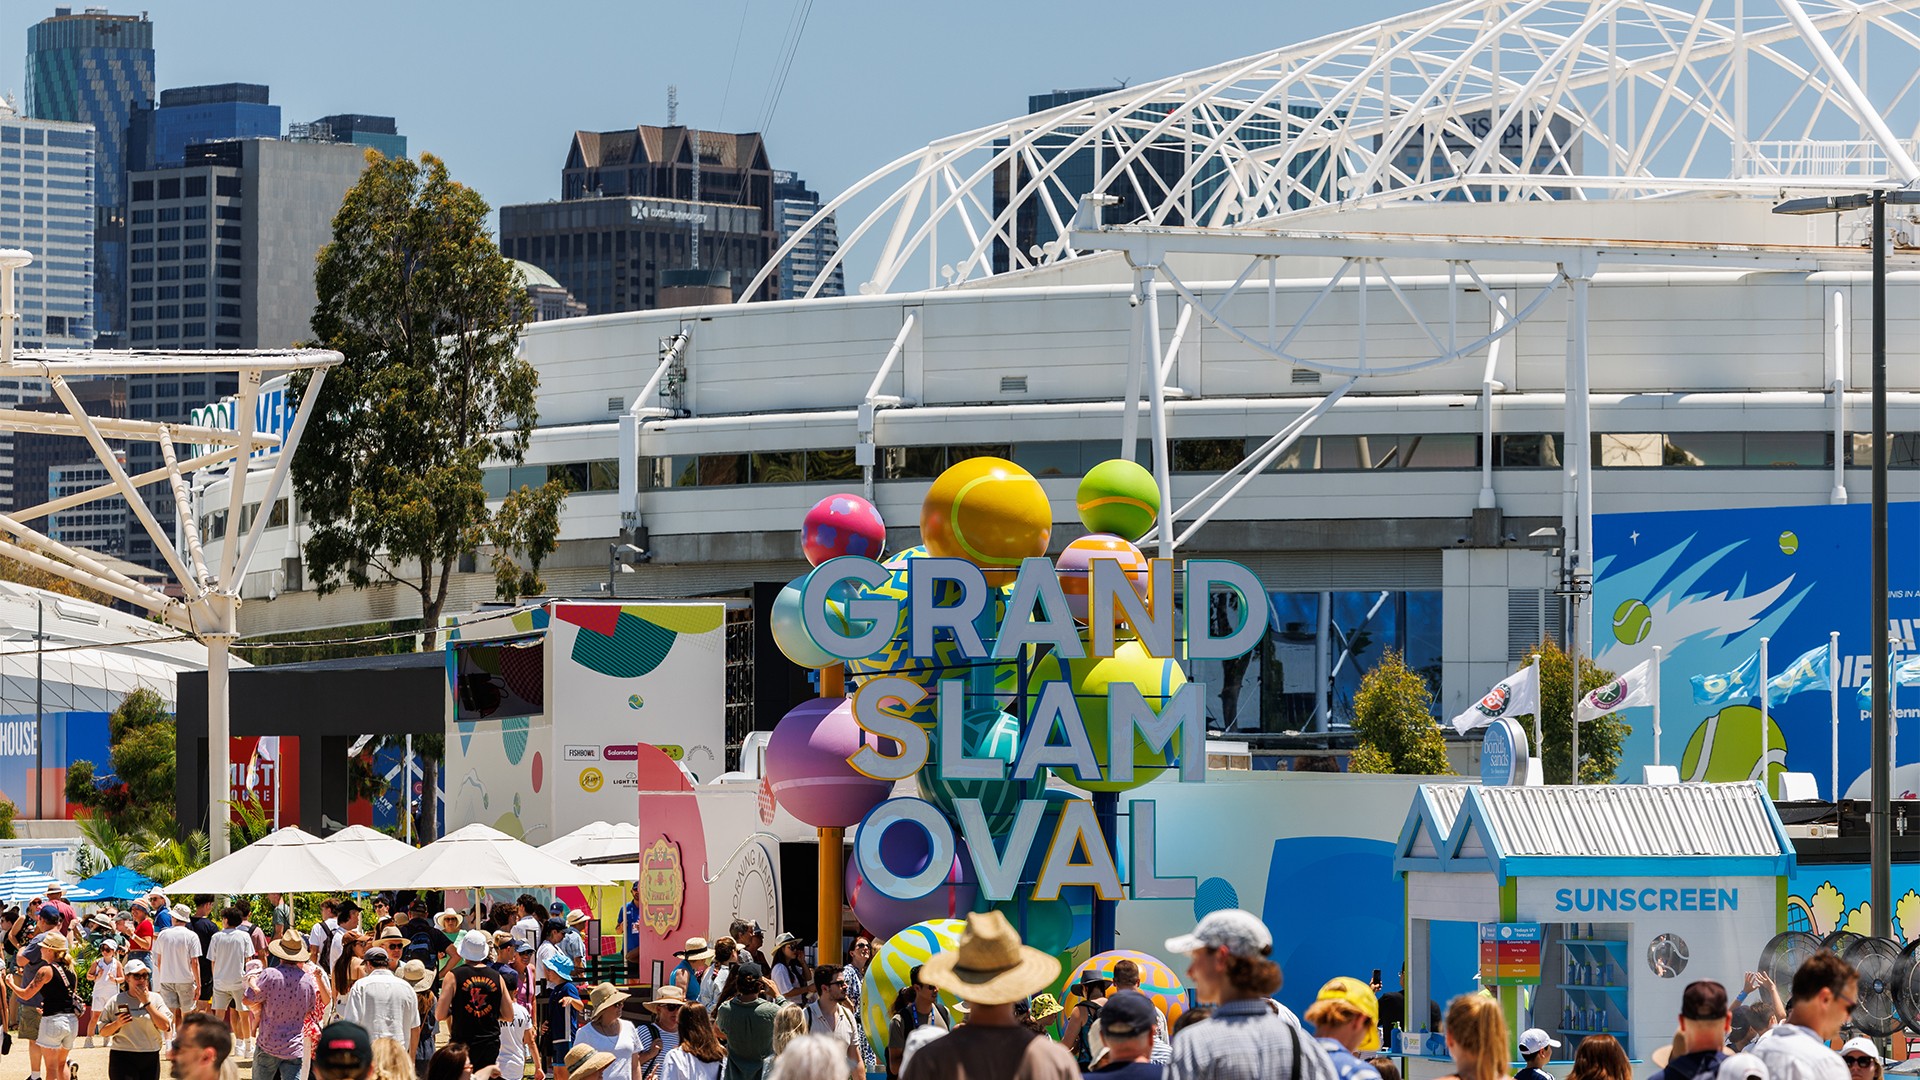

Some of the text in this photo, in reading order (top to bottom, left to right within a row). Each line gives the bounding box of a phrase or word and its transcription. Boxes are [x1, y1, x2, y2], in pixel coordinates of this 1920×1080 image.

[802, 557, 1269, 660] GRAND
[0, 721, 38, 756] HOUSE
[846, 676, 1207, 783] SLAM
[1484, 736, 1506, 754] bondi
[1490, 753, 1509, 767] sands
[379, 795, 393, 810] LIVE
[856, 797, 1198, 901] OVAL
[1555, 888, 1739, 912] SUNSCREEN
